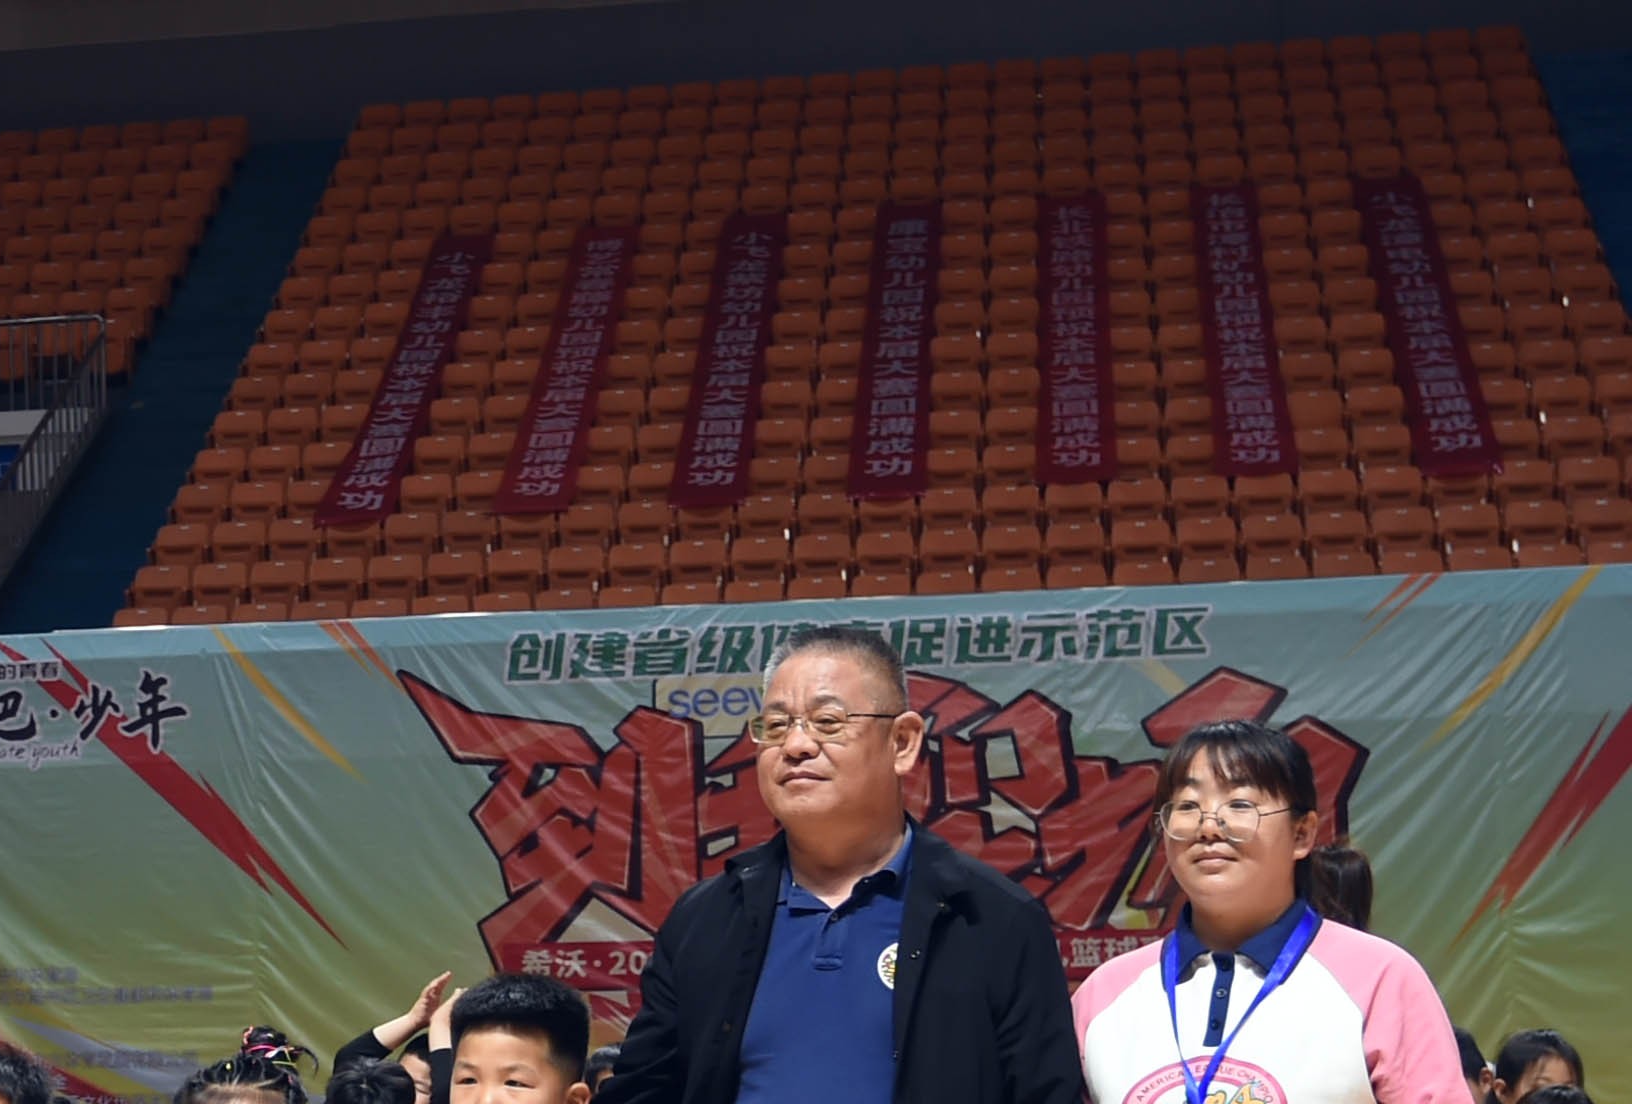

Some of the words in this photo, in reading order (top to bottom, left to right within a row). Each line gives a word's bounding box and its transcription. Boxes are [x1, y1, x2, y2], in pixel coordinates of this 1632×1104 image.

[507, 606, 1212, 682] 创建省级促进示范区
